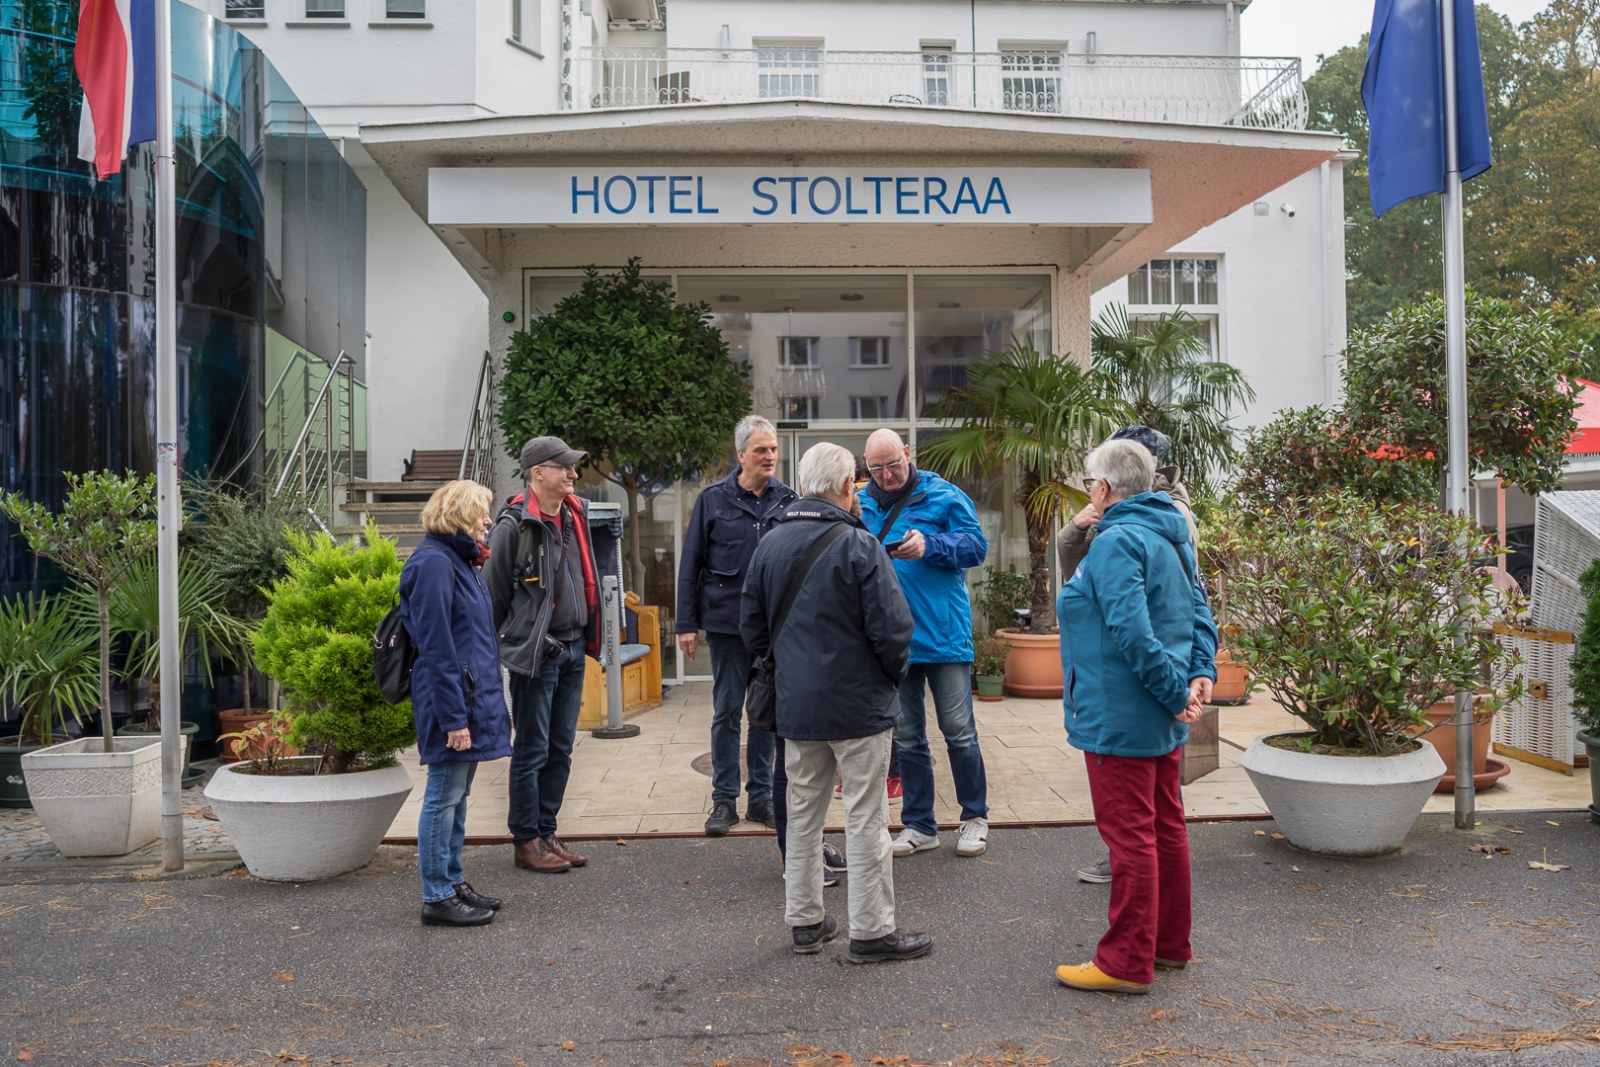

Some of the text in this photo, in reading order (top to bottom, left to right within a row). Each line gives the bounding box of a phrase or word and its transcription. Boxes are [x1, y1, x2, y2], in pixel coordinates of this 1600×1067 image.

[571, 176, 1011, 215] HOTEL STOLTERAA
[606, 636, 614, 666] SMOKERS
